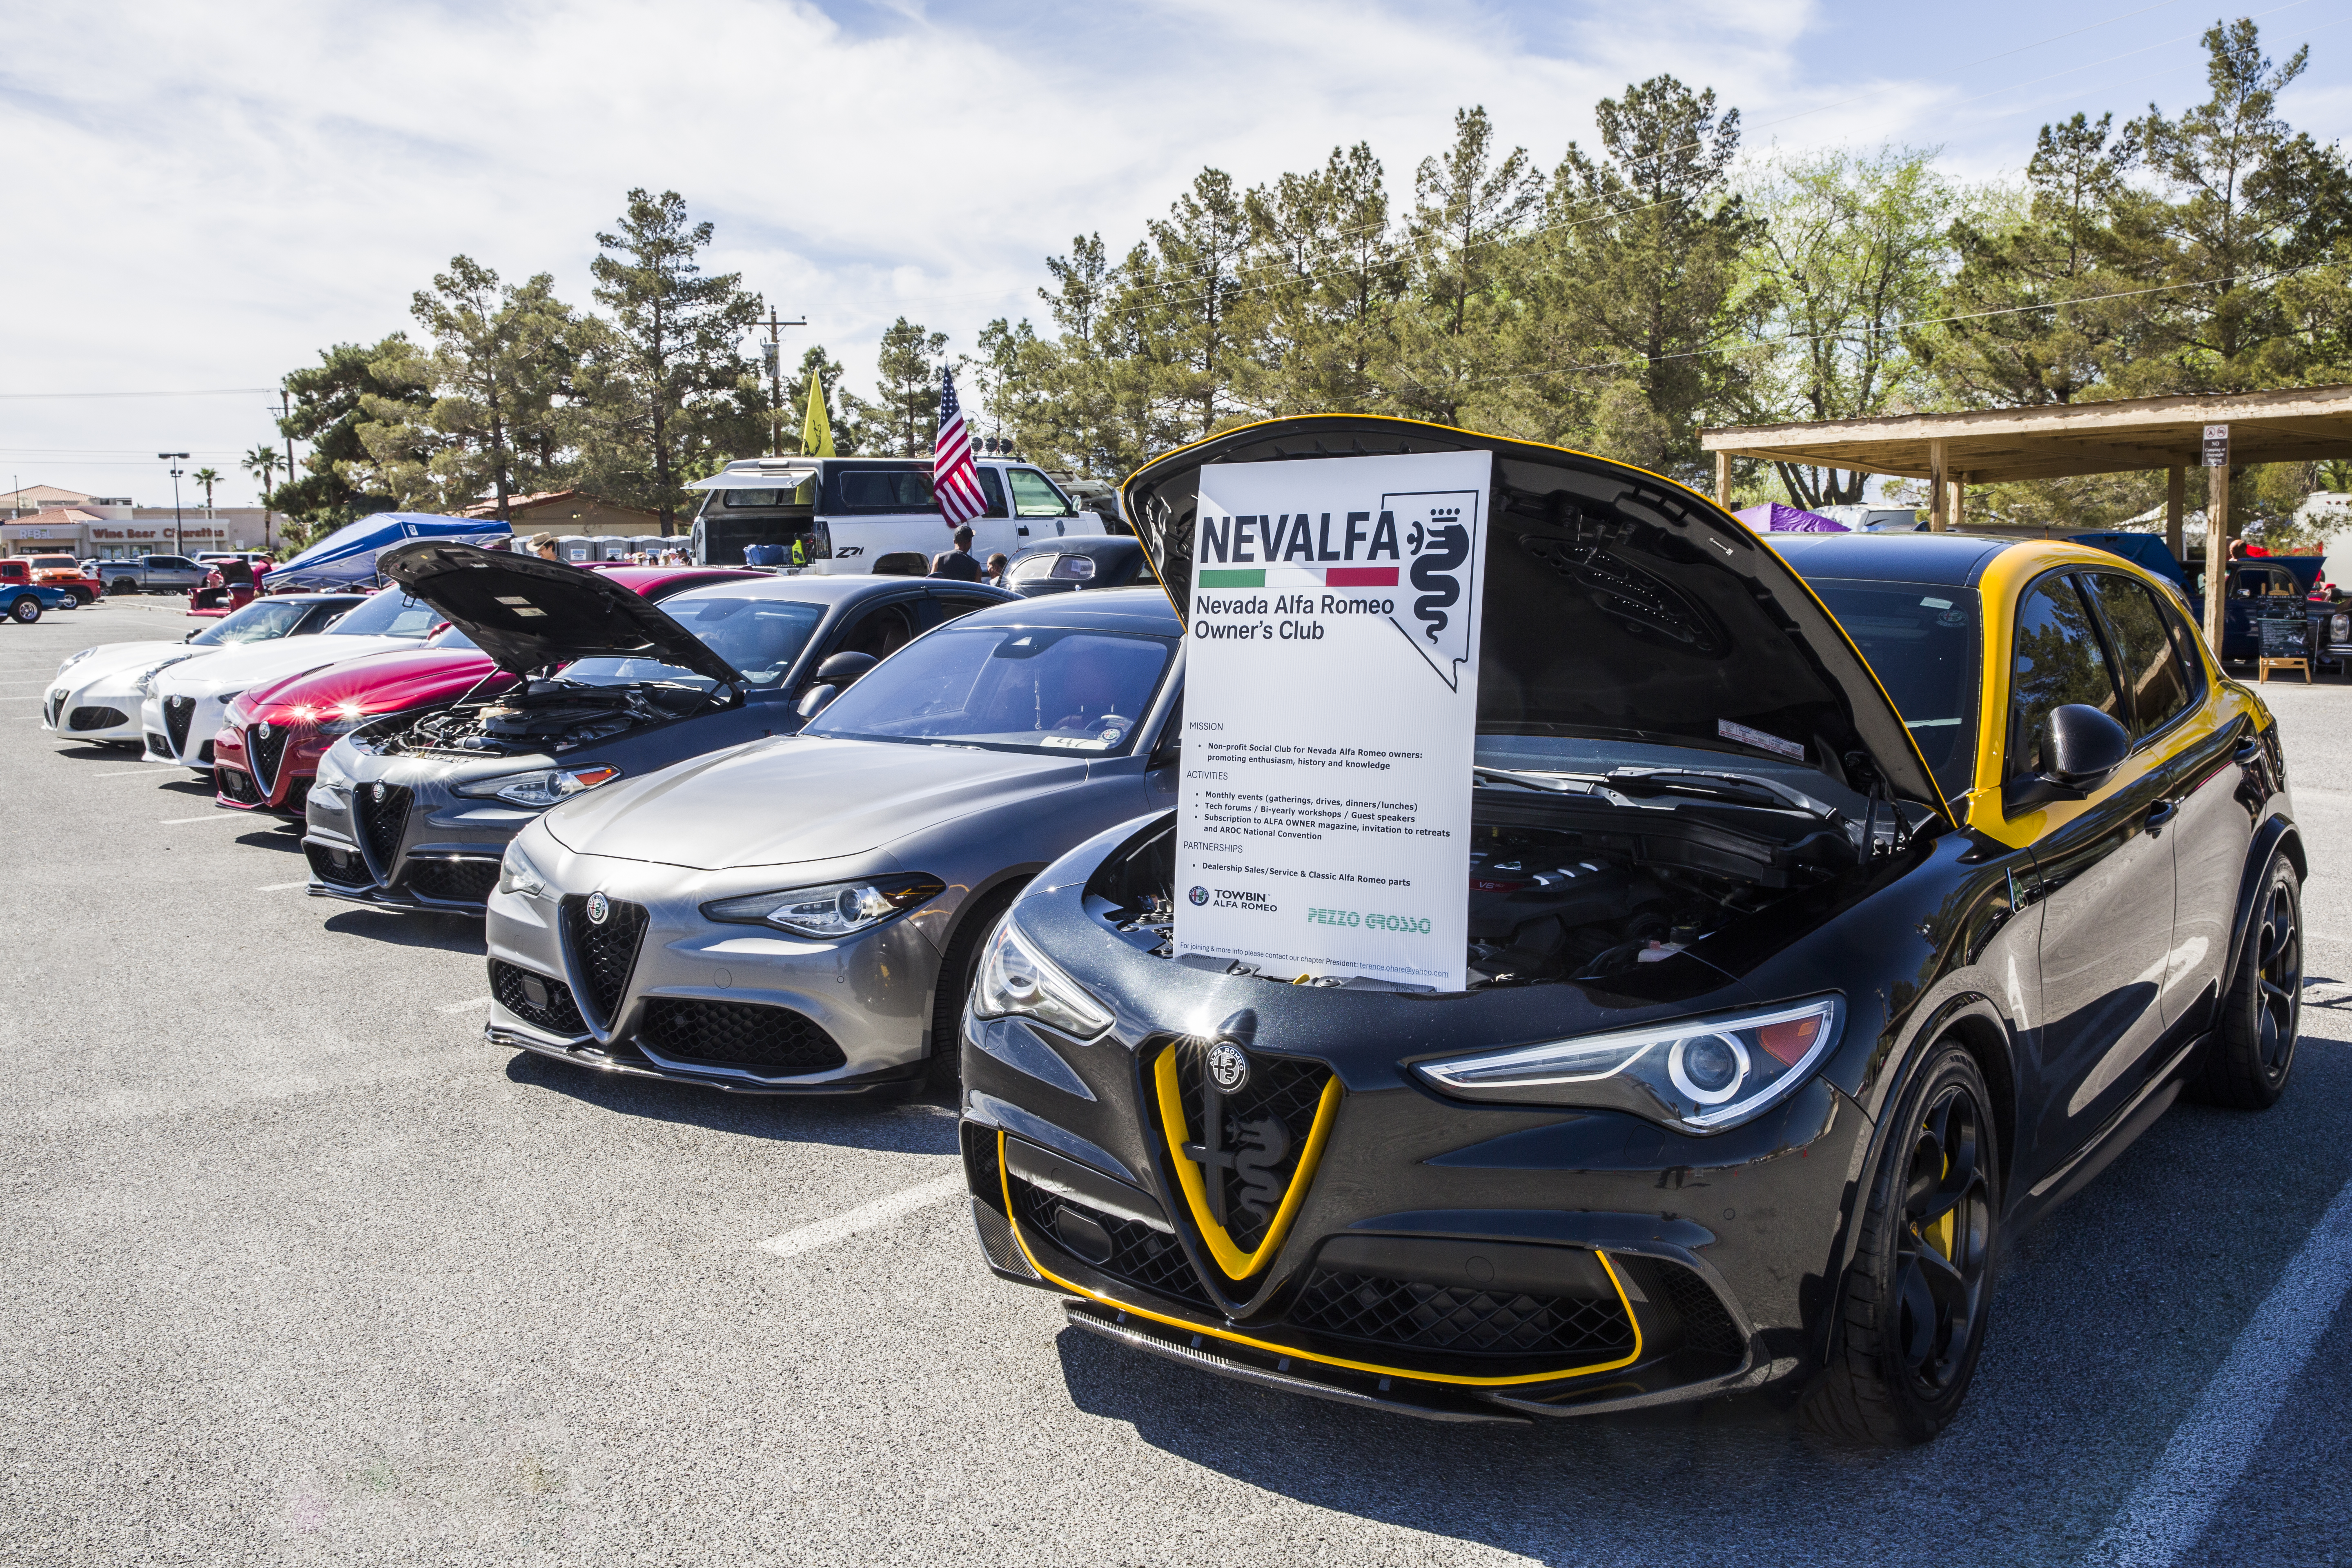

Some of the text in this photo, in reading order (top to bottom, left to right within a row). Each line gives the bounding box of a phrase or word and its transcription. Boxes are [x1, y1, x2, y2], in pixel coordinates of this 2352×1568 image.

[20, 529, 53, 539] REBEL
[93, 528, 124, 539] Wine
[127, 529, 156, 538] Beer
[1200, 511, 1400, 564] NEVALFA
[835, 547, 864, 559] Z71
[1197, 595, 1394, 614] Nevada Alfa Romeo
[1195, 621, 1324, 640] Owner's Club
[1190, 722, 1223, 731] MISSION
[1057, 738, 1091, 748] 47
[1208, 743, 1247, 751] Non-profit
[1207, 755, 1246, 764] promoting
[1249, 756, 1295, 766] enthusiasm,
[1298, 758, 1325, 768] history
[1346, 760, 1390, 771] knowledge
[1187, 771, 1228, 780] ACTIVITIES
[1206, 791, 1235, 800] Monthly
[1266, 794, 1313, 805] (gatherings,
[1316, 797, 1342, 807] drives,
[1346, 800, 1417, 812] dinners/lunches)
[1225, 804, 1251, 812] forums
[1254, 805, 1258, 813] /
[1261, 806, 1295, 816] Bi-yearly
[1298, 809, 1341, 819] workshops
[1344, 811, 1348, 819] /
[1352, 812, 1375, 820] Guest
[1377, 814, 1415, 822] speakers
[1205, 814, 1251, 824] Subscription
[1286, 820, 1315, 828] OWNER
[1319, 822, 1359, 832] magazine,
[1363, 824, 1401, 834] invitation
[1416, 829, 1450, 837] retreats
[1244, 828, 1275, 837] National
[1278, 831, 1321, 840] Convention
[1184, 841, 1243, 853] PARTNERSHIPS
[1203, 863, 1242, 873] Dealership
[1245, 866, 1298, 876] Sales/Service
[1309, 871, 1336, 880] Classic
[1358, 875, 1385, 884] Romeo
[1198, 886, 1209, 897] ROMEO
[1214, 889, 1266, 902] TOWBIN
[1213, 900, 1277, 912] ALFA ROMEO
[1308, 908, 1431, 934] PEZZO GROSSO
[1190, 943, 1209, 952] joining
[1301, 956, 1324, 964] chapter
[1326, 958, 1358, 968] President:
[1359, 962, 1449, 978] terence.ohare@yahoo.com
[1210, 1048, 1244, 1071] ALFA ROMEO
